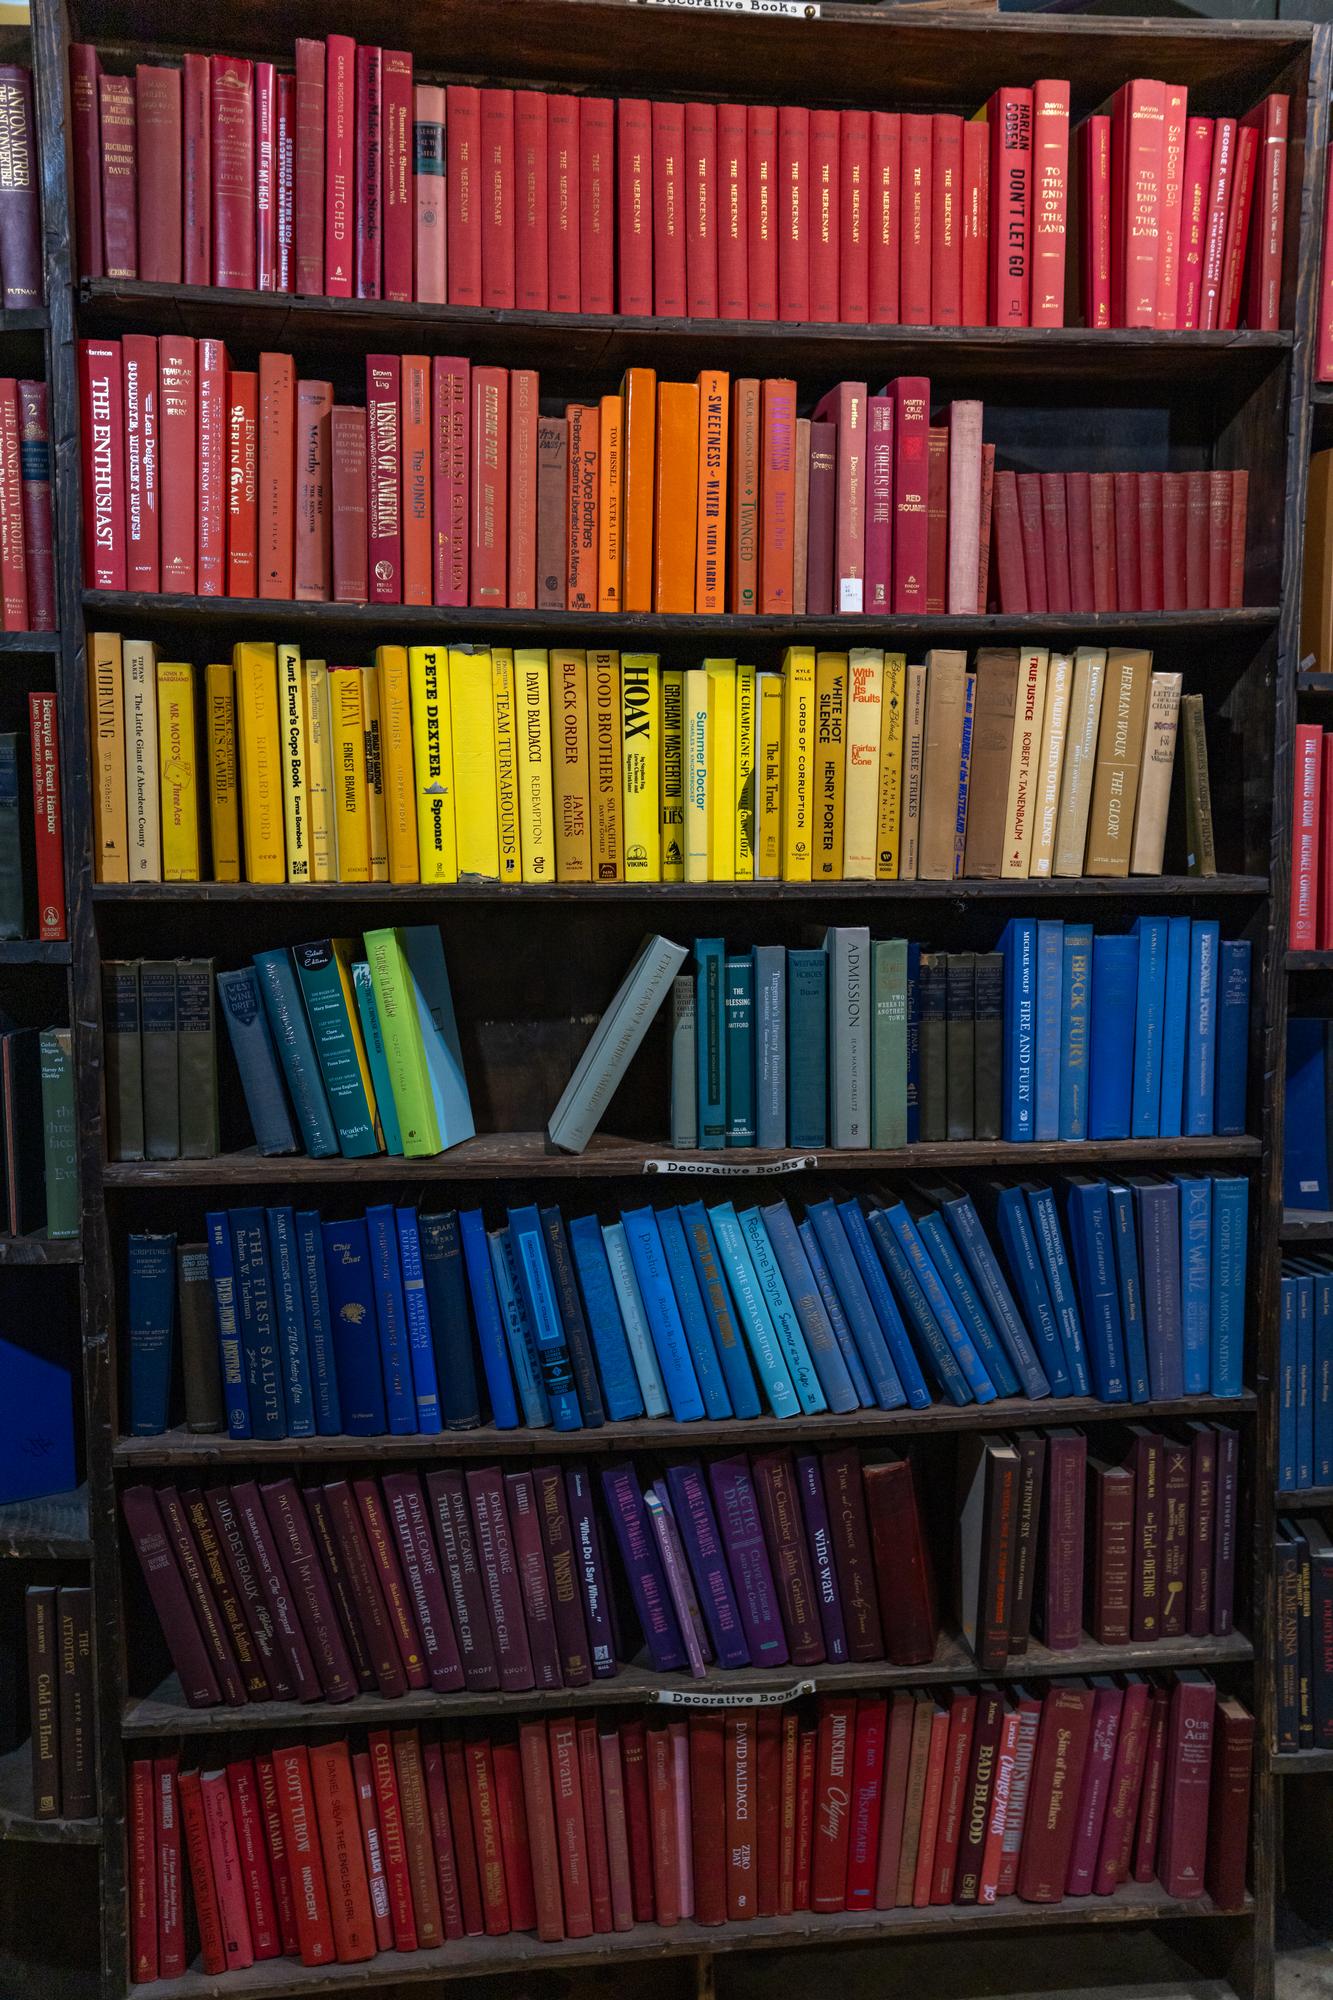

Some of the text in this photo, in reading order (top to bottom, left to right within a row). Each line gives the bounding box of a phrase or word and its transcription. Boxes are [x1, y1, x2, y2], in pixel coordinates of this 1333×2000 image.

[751, 2, 798, 13] Books
[8, 87, 29, 186] ANTON MYRER
[260, 142, 272, 159] OUT
[1005, 103, 1018, 150] COBEN
[1019, 104, 1029, 150] HARLAN
[1221, 125, 1231, 165] GEORGE
[258, 170, 269, 183] MY
[258, 186, 269, 209] HEAD
[334, 175, 344, 240] HITCHED
[631, 155, 641, 234] THE MERCENARY
[790, 162, 800, 241] THE MERCENARY
[1217, 178, 1226, 202] WILL
[1009, 169, 1025, 277] DON'T LET GO
[92, 377, 113, 550] THE ENTHUSIAST
[143, 414, 154, 489] Len Deighton
[377, 401, 397, 538] VISIONS OF AMERICA
[413, 449, 424, 518] The PUNCH
[706, 395, 721, 517] SWEETNESS WATER
[873, 444, 889, 523] STREETS OF FIRE
[583, 451, 596, 548] Dr. Joyce Brothers
[609, 427, 618, 560] TOM BISSELL EXTRA LIVES
[97, 660, 115, 738] MORNING
[286, 655, 301, 788] Aunt Erma's Cope Book
[424, 653, 441, 778] PETE DEXTER
[526, 672, 541, 762] DAVID BALDACCI
[563, 663, 578, 764] BLACK ORDER
[596, 654, 613, 793] BLOOD BROTHERS
[624, 666, 650, 740] HOAX
[819, 694, 830, 743] SILENCE
[832, 676, 843, 743] WHITE HOT
[1024, 657, 1039, 721] TRUE JUSTICE
[1114, 665, 1133, 758] HERMAN WOUK
[42, 699, 57, 834] Betrayal at Pearl Harbor
[135, 694, 146, 847] The Little Giant of Aberdeen County
[343, 742, 356, 813] ERNEST BRAWLEY
[496, 691, 516, 854] TEAM TURNAROUNDS
[664, 684, 681, 797] GRAHAM MASTERTON
[696, 712, 707, 810] Summer Doctor
[766, 741, 779, 814] The Ink Truck
[563, 795, 573, 837] ROLLINS
[573, 796, 584, 836] JAMES
[823, 761, 835, 850] HENRY PORTER
[1107, 771, 1125, 839] THE GLORY
[1302, 739, 1317, 826] THE BURNING ROOM
[432, 799, 444, 851] Spooner
[847, 942, 860, 1027] ADMISSION
[1022, 931, 1030, 994] MICHAEL WOLFF
[1018, 1000, 1031, 1102] FIRE AND FURY
[667, 1161, 798, 1174] Decorative Books
[744, 1217, 784, 1308] RaeAnne Thayne
[248, 1228, 278, 1422] THE FIRST SALUTE
[735, 1263, 776, 1369] THE DELTA SOLUTION
[1037, 1303, 1054, 1342] LACED
[406, 1493, 435, 1575] JOHN LE CARRÉ
[723, 1488, 744, 1535] DRIFT
[734, 1474, 758, 1533] ARCTIC
[215, 1497, 258, 1600] JUDE DEVERAUX
[392, 1495, 438, 1655] THE LITTLE DRUMMER GIRL
[583, 1546, 593, 1560] Do
[584, 1567, 597, 1583] Say
[813, 1528, 836, 1603] wine wars
[38, 1674, 53, 1760] Cold in Hand
[672, 1687, 799, 1704] Decorative Books
[375, 1743, 402, 1865] CHINA WHITE
[556, 1731, 573, 1798] Havana
[736, 1723, 747, 1820] DAVID BALDACCI
[968, 1744, 994, 1844] BAD BLOOD
[1047, 1728, 1070, 1829] Sins of the Fathers
[284, 1757, 310, 1853] SCOTT TUROW
[301, 1866, 318, 1921] INNOCENT
[732, 1848, 741, 1867] DAY
[741, 1844, 750, 1869] ZERO
